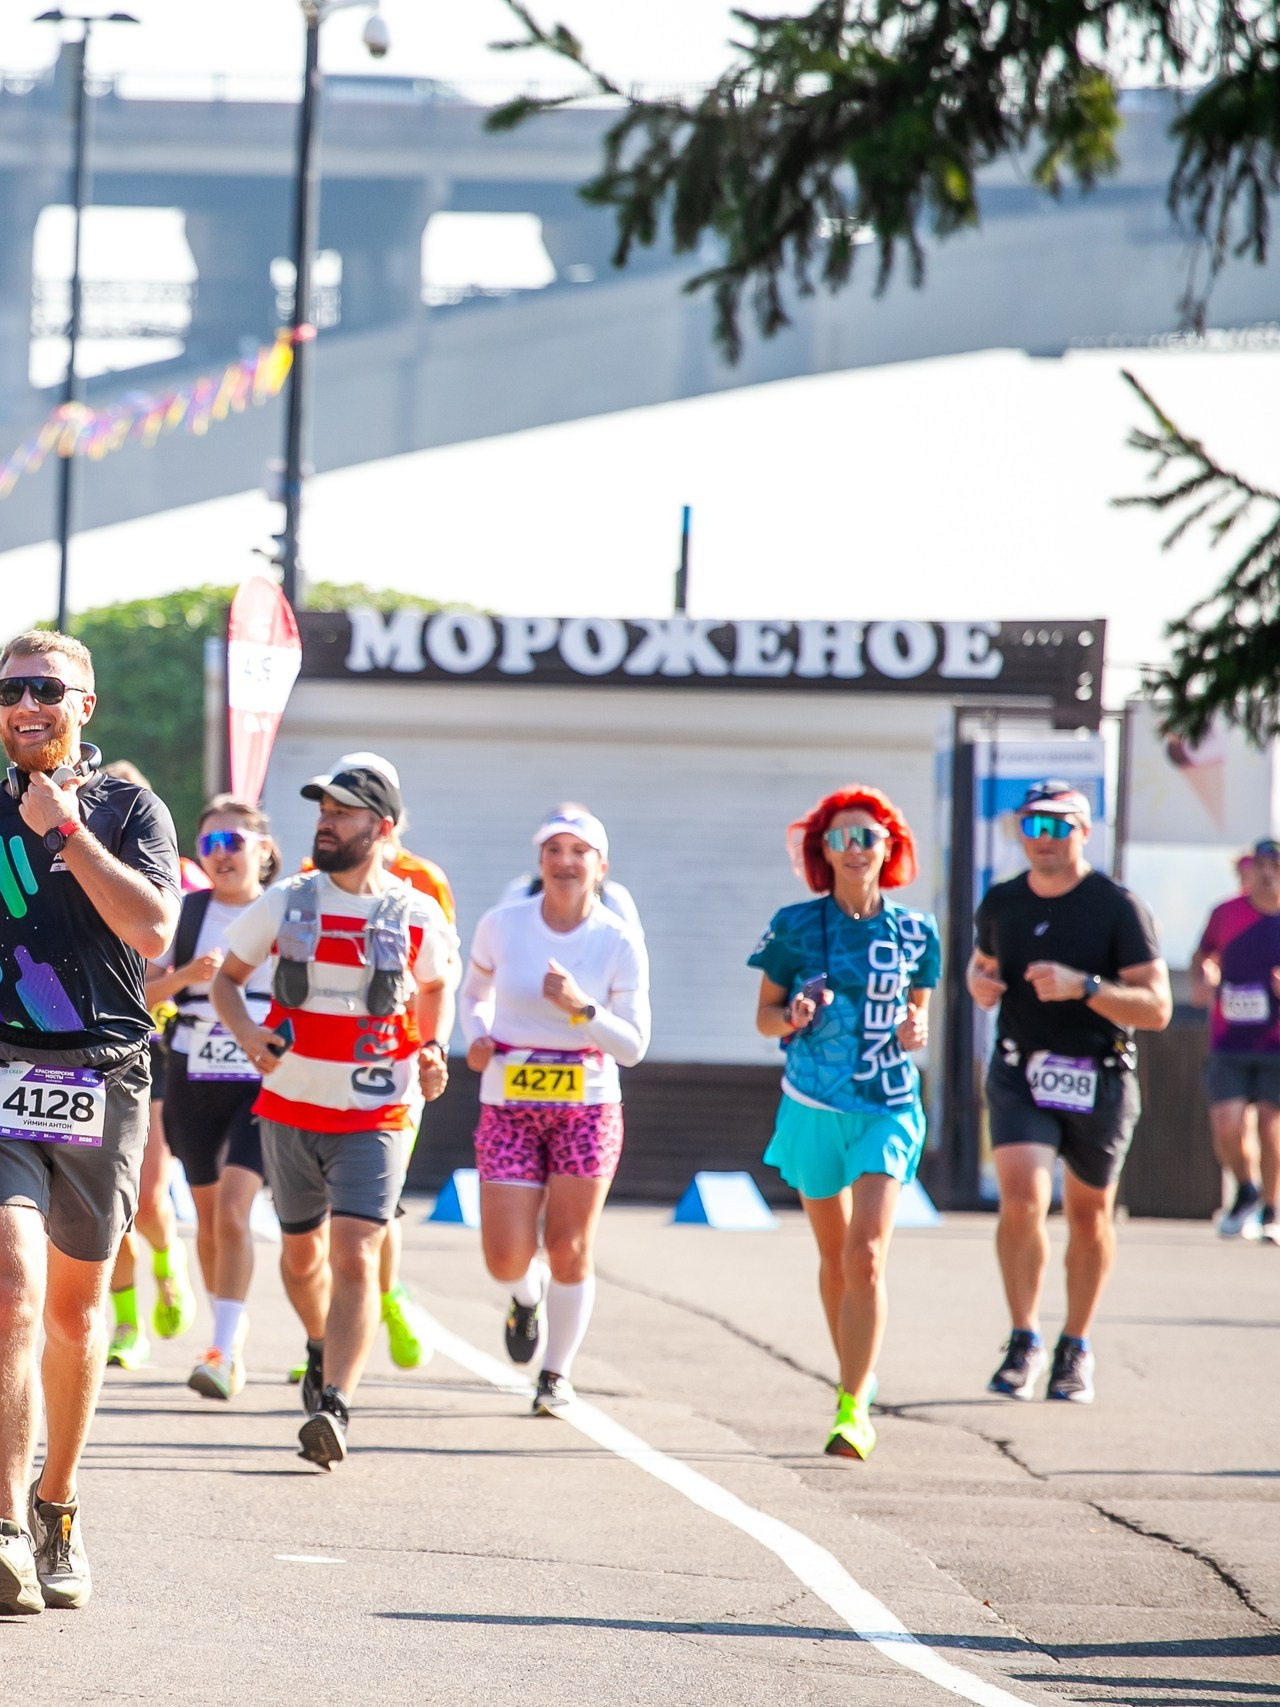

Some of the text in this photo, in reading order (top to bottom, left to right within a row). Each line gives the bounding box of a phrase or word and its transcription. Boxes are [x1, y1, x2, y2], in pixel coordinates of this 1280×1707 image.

[345, 605, 1004, 680] МОРОЖЕНОЕ
[511, 1069, 576, 1092] 4271
[2, 1086, 95, 1122] 4128
[23, 1118, 47, 1127] УЙМИН
